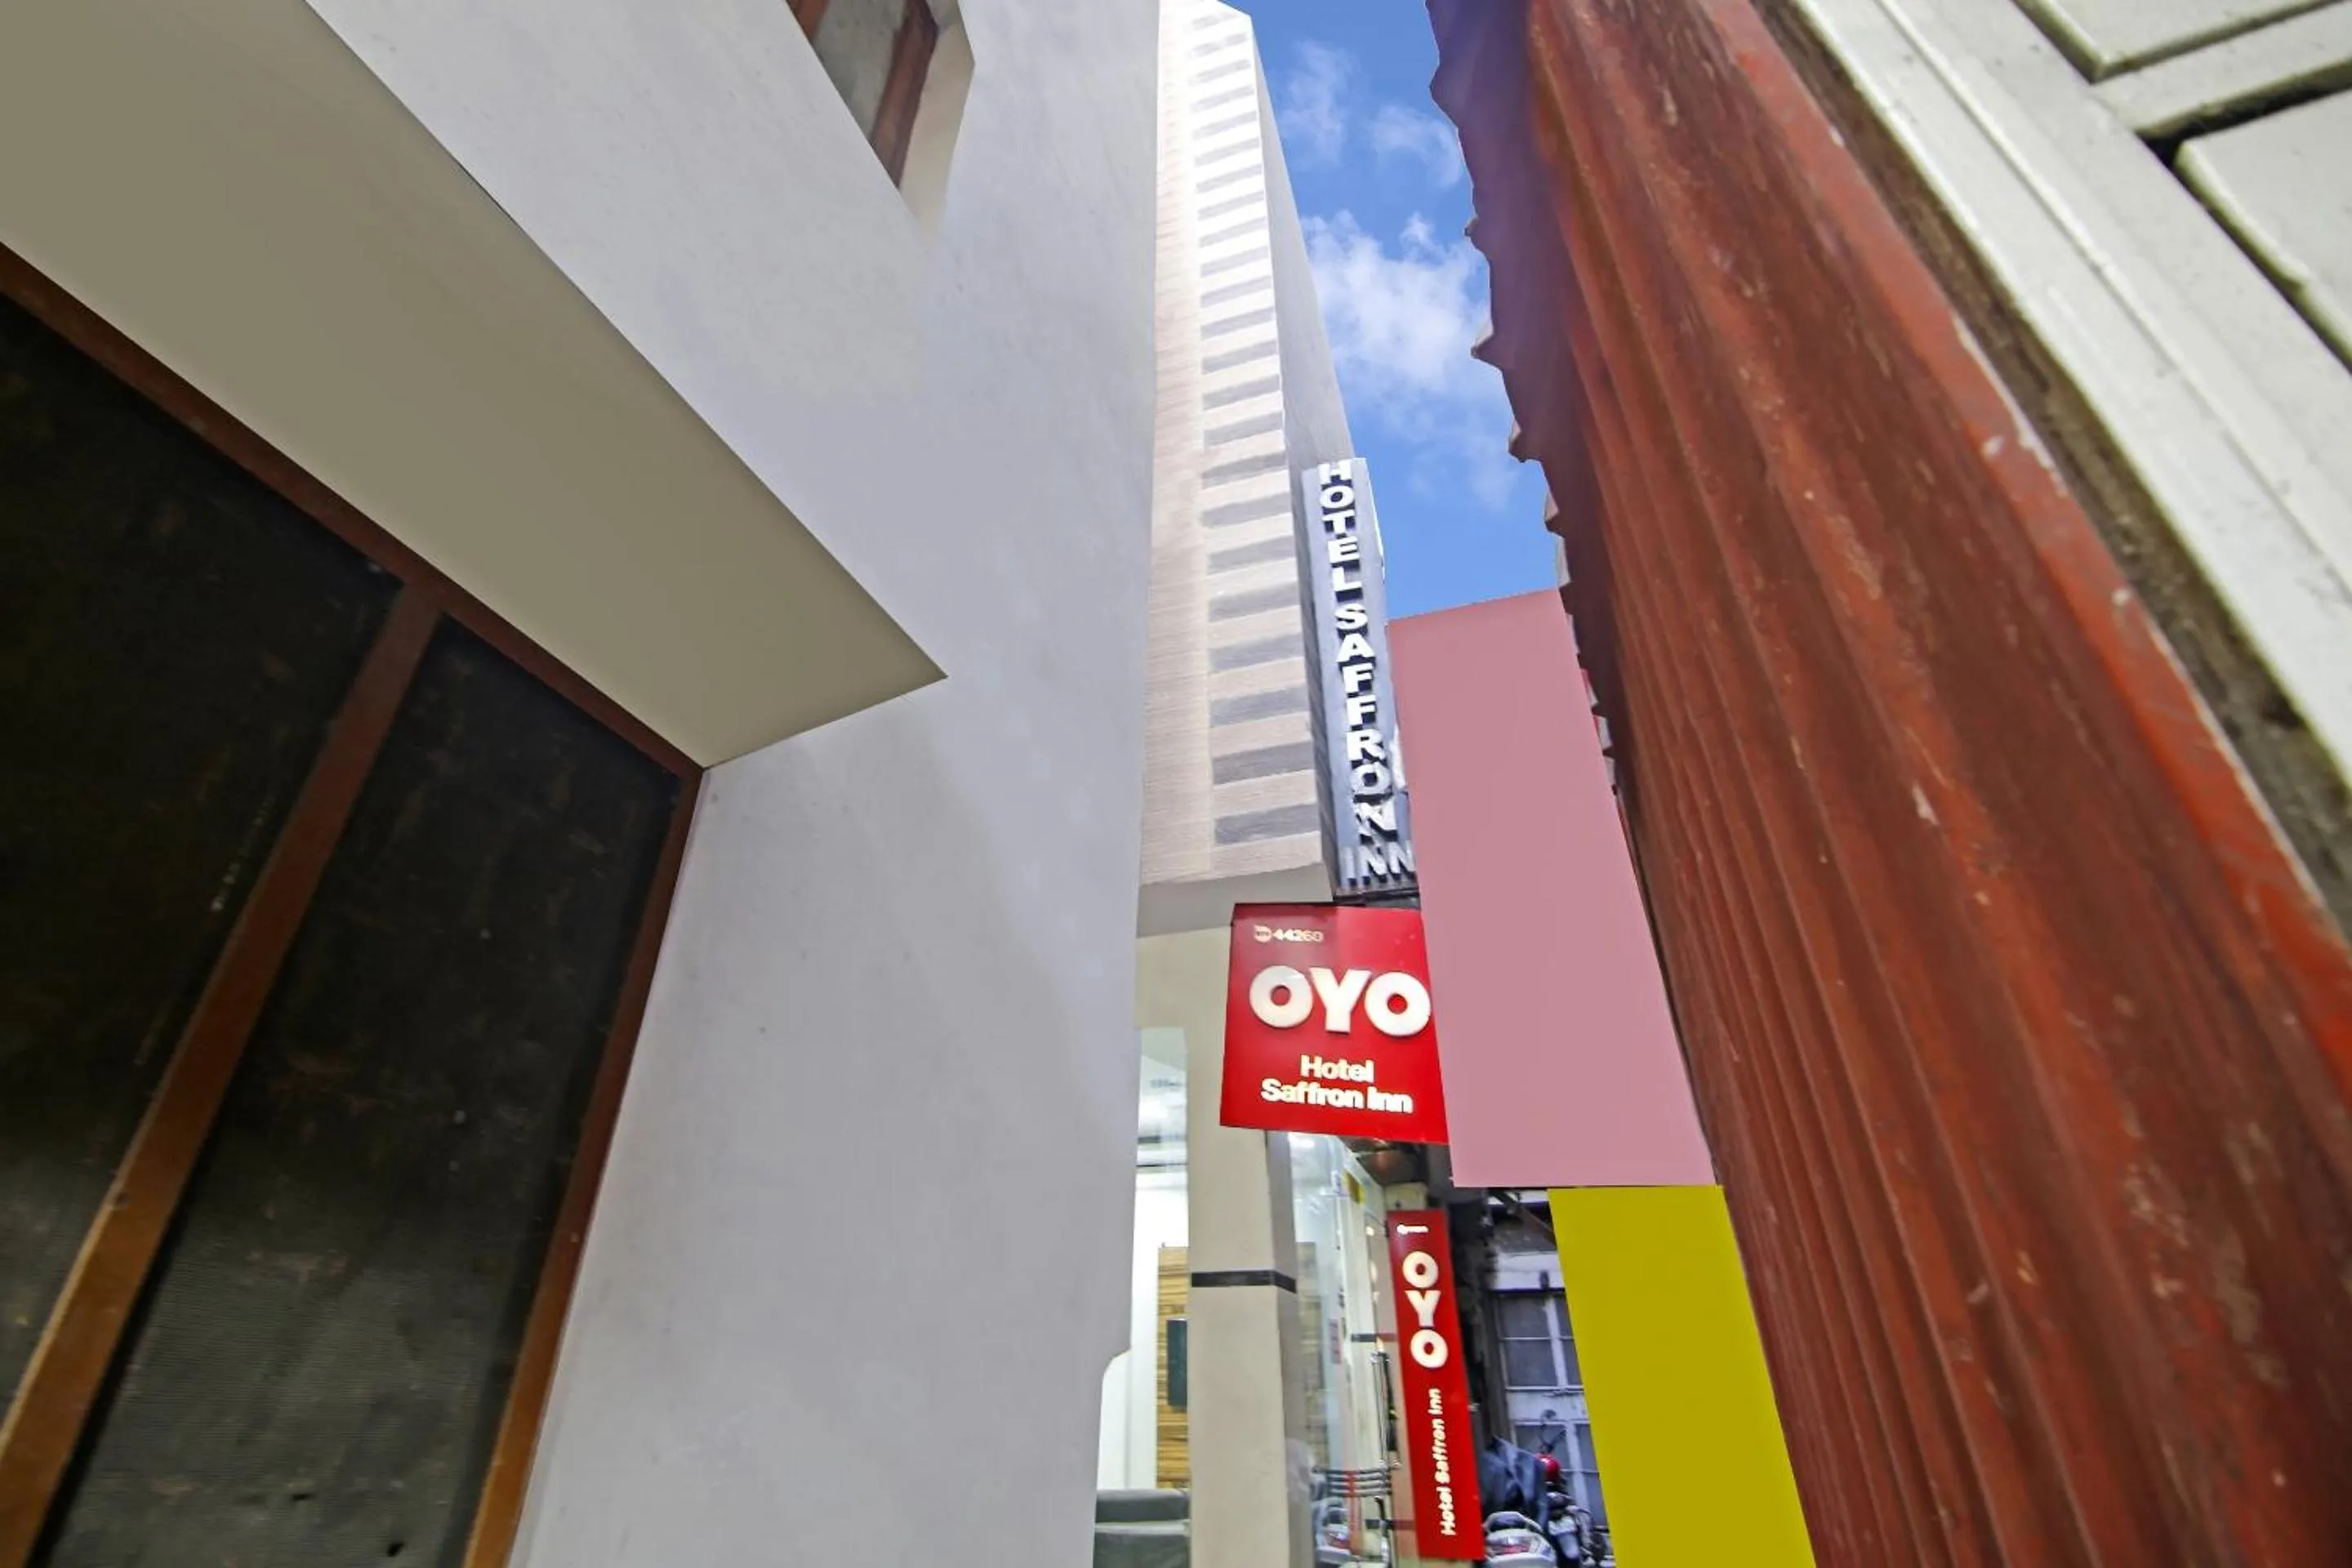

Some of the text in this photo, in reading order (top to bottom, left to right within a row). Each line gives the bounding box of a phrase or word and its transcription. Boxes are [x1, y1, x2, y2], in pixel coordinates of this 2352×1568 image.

[1318, 462, 1396, 835] HOTEL SAFFRON
[1343, 841, 1415, 879] INN
[1250, 965, 1432, 1036] OYO
[1261, 1078, 1414, 1113] Saffron Inn
[1300, 1055, 1374, 1082] Hotel
[1402, 1251, 1449, 1369] OYO
[1428, 1388, 1456, 1536] Hotel Saffron Inn
